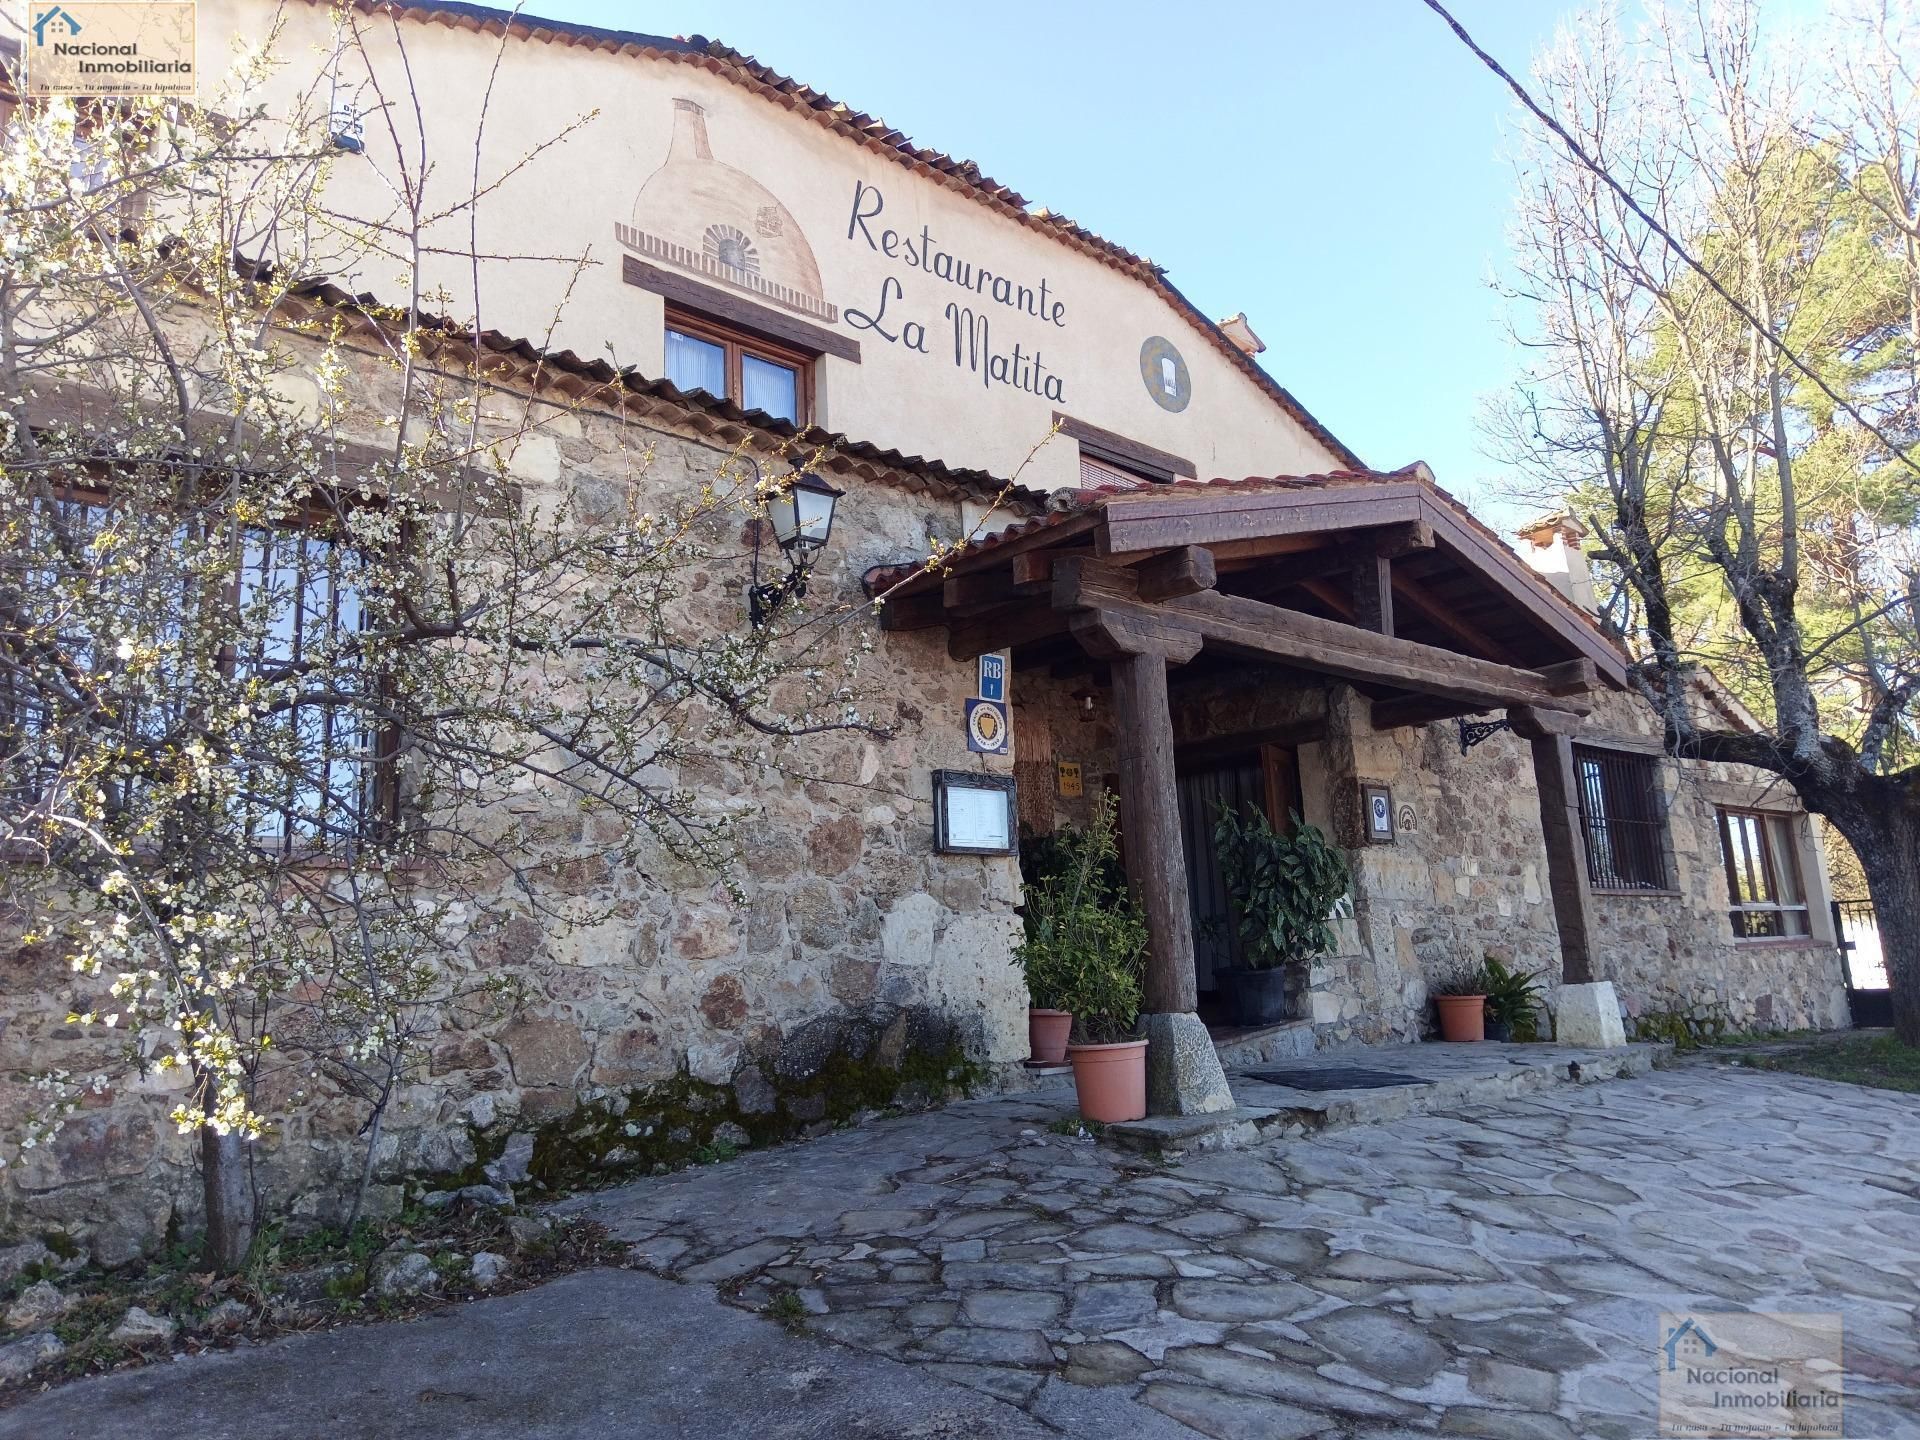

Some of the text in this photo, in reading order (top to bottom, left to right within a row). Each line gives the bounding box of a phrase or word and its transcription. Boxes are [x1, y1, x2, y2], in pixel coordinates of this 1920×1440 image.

[847, 179, 1066, 328] Restaurante
[843, 276, 1067, 404] La Matita
[983, 660, 1001, 679] RB
